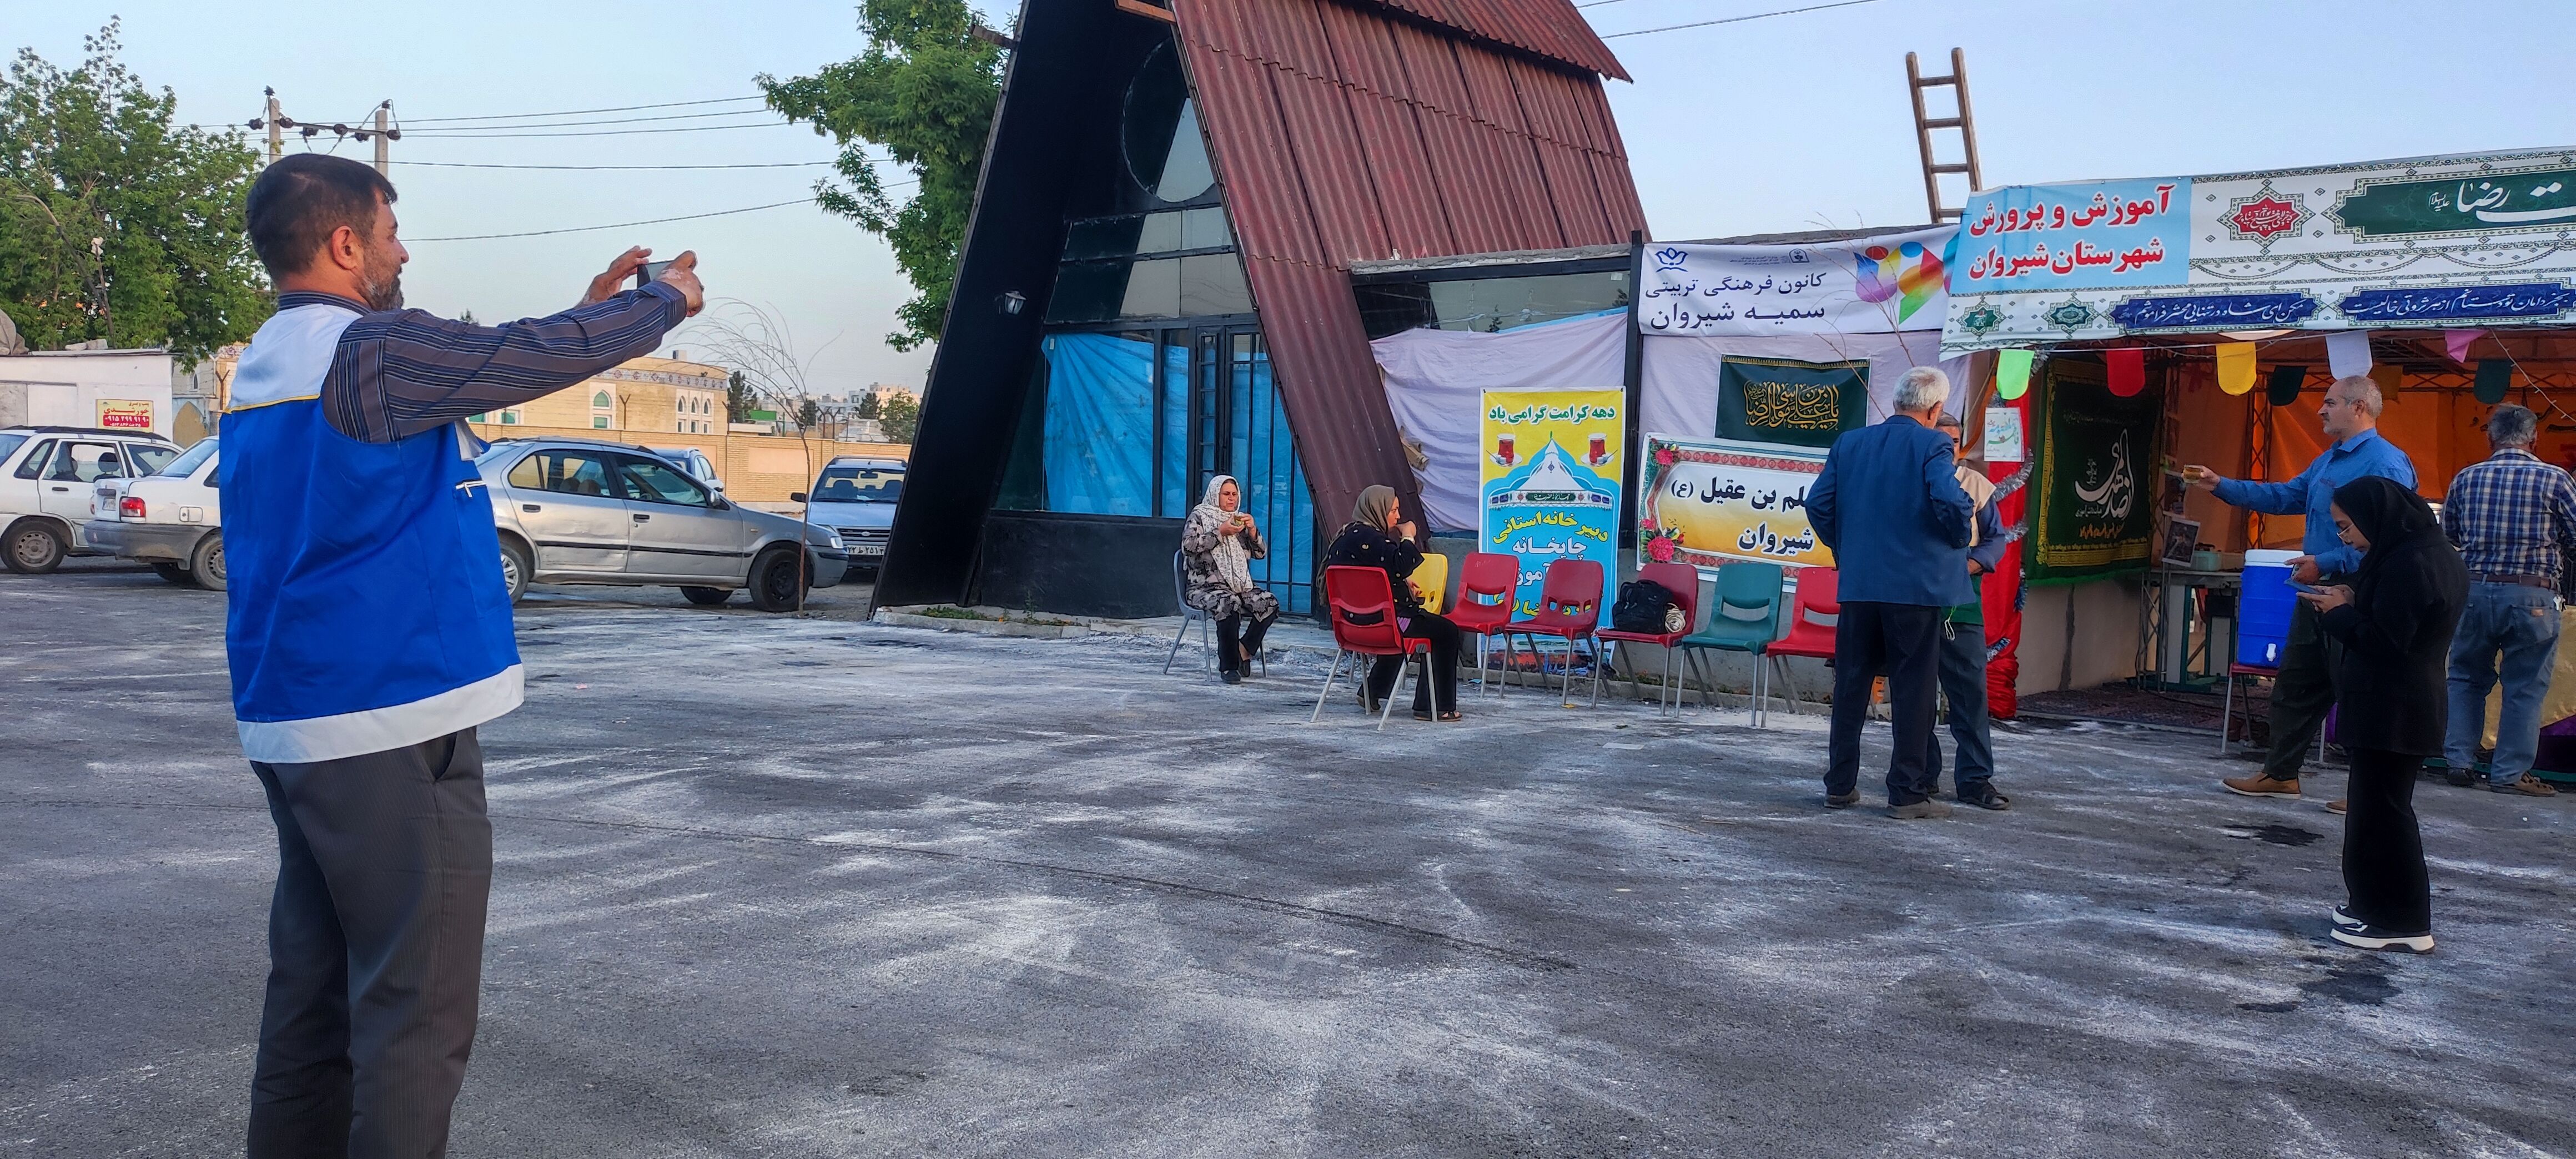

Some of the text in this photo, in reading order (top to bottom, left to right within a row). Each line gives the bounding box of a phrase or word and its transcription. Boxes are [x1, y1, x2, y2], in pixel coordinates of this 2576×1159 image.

[1970, 184, 2175, 236] آموزش و پرورش
[1970, 238, 2164, 279] شهرستان شیروان
[1645, 273, 1827, 298] کانون فرهنگی تربیتی
[1651, 302, 1825, 329] سمیه شیروان
[1489, 405, 1615, 423] دهه کرامت گرامی باد
[1671, 480, 1694, 498] (ع)
[1700, 476, 1745, 504] عقیل
[1751, 489, 1776, 510] بن
[1493, 511, 1542, 543] استانی
[1739, 523, 1814, 554] شیروان
[1512, 536, 1587, 560] چایخانه
